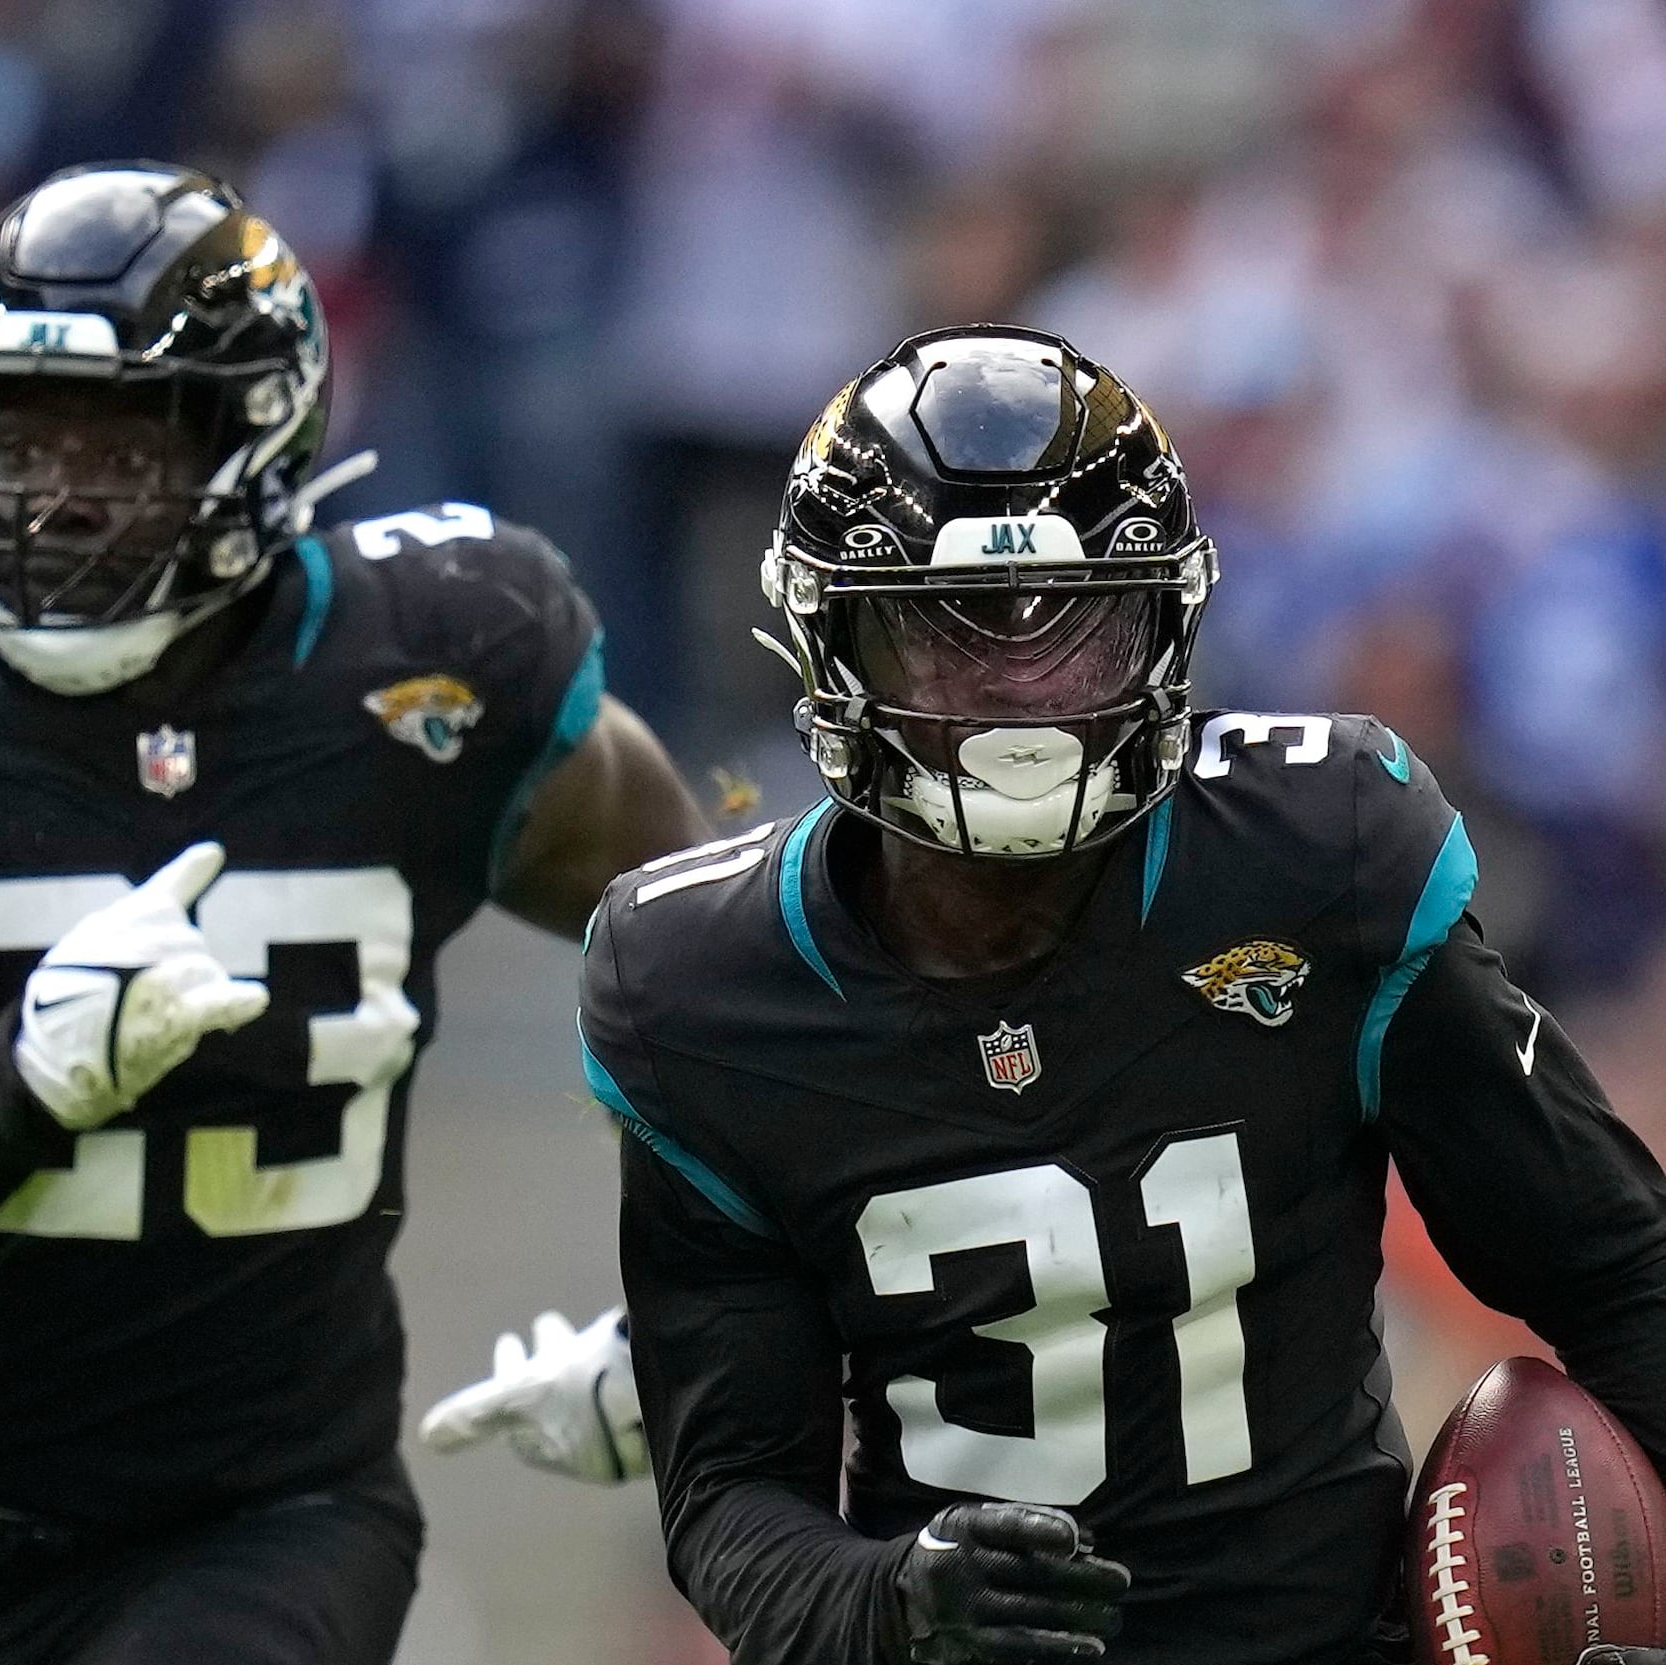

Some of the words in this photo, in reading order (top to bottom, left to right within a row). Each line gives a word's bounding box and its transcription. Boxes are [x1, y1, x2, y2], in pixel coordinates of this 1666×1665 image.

[840, 546, 896, 560] OAKLEY
[981, 523, 1037, 554] JAX
[1115, 541, 1164, 552] OAKLEY
[991, 1052, 1031, 1081] NFL
[855, 1132, 1255, 1506] 31
[1558, 1427, 1582, 1488] LEAGUE
[1571, 1496, 1597, 1595] FOOTBALL
